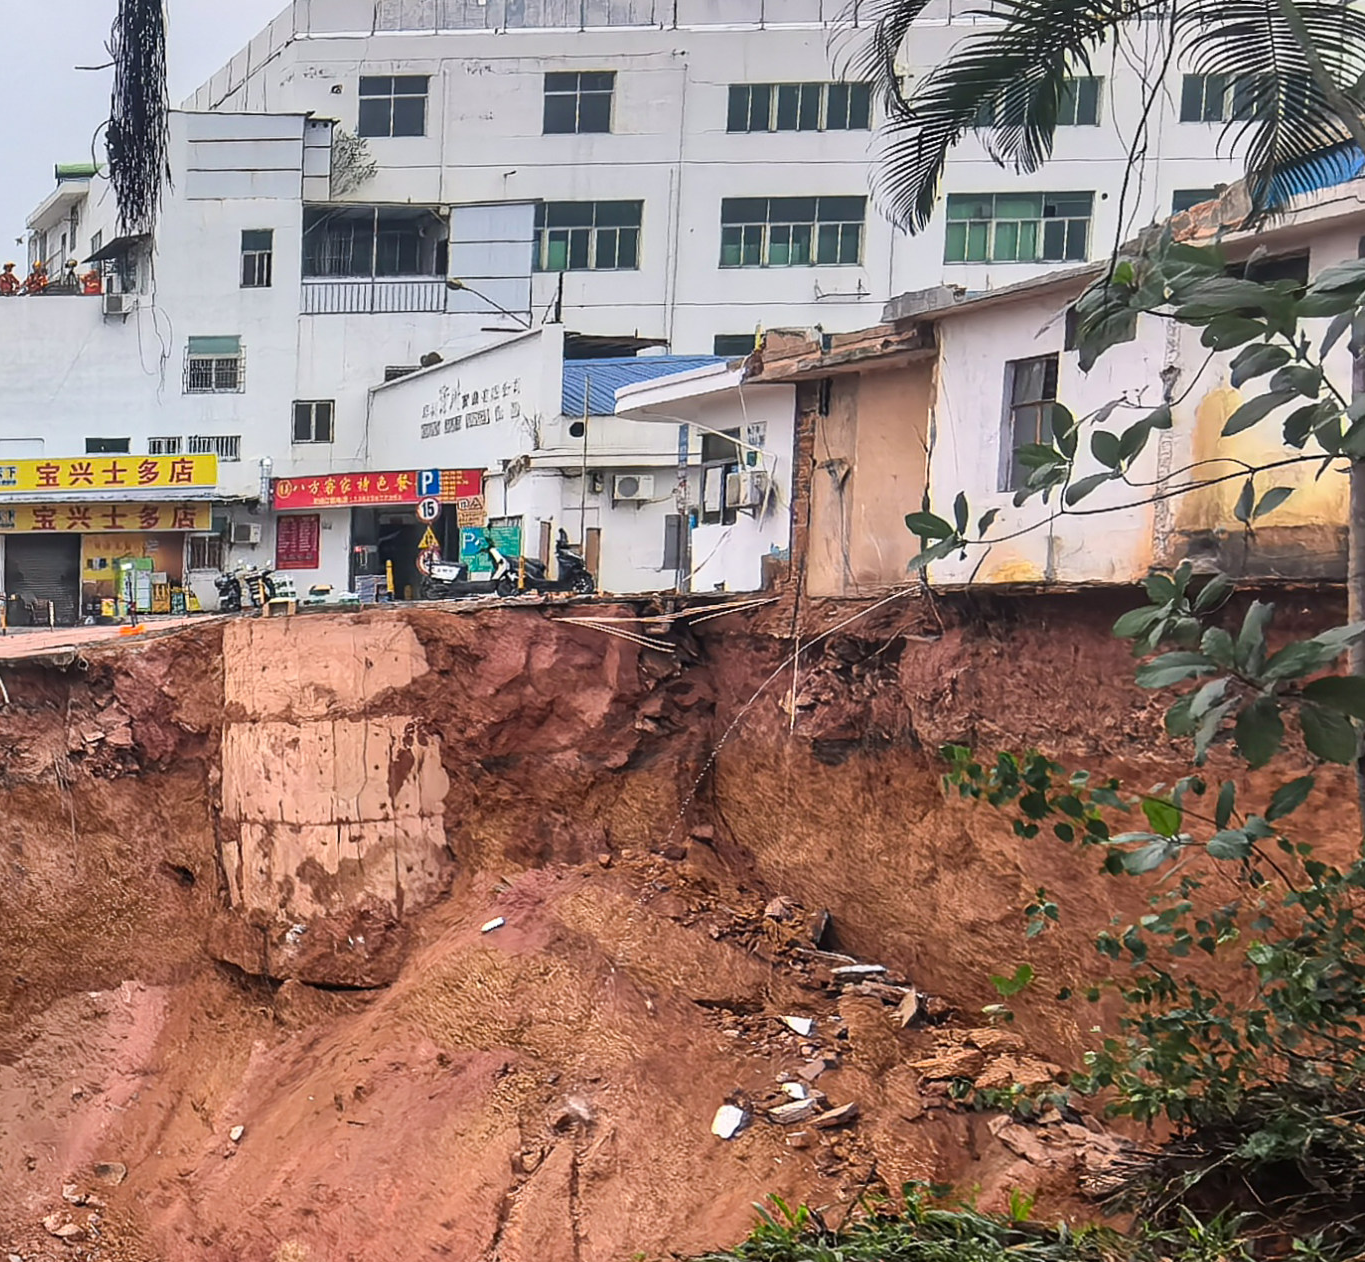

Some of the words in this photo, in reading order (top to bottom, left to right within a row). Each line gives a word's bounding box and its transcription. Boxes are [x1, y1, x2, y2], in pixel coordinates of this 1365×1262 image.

[35, 457, 195, 487] 宝兴士多店
[422, 471, 433, 495] P
[293, 473, 417, 496] 八方客家特色餐
[32, 504, 196, 531] 宝兴士多店
[422, 501, 435, 518] 15
